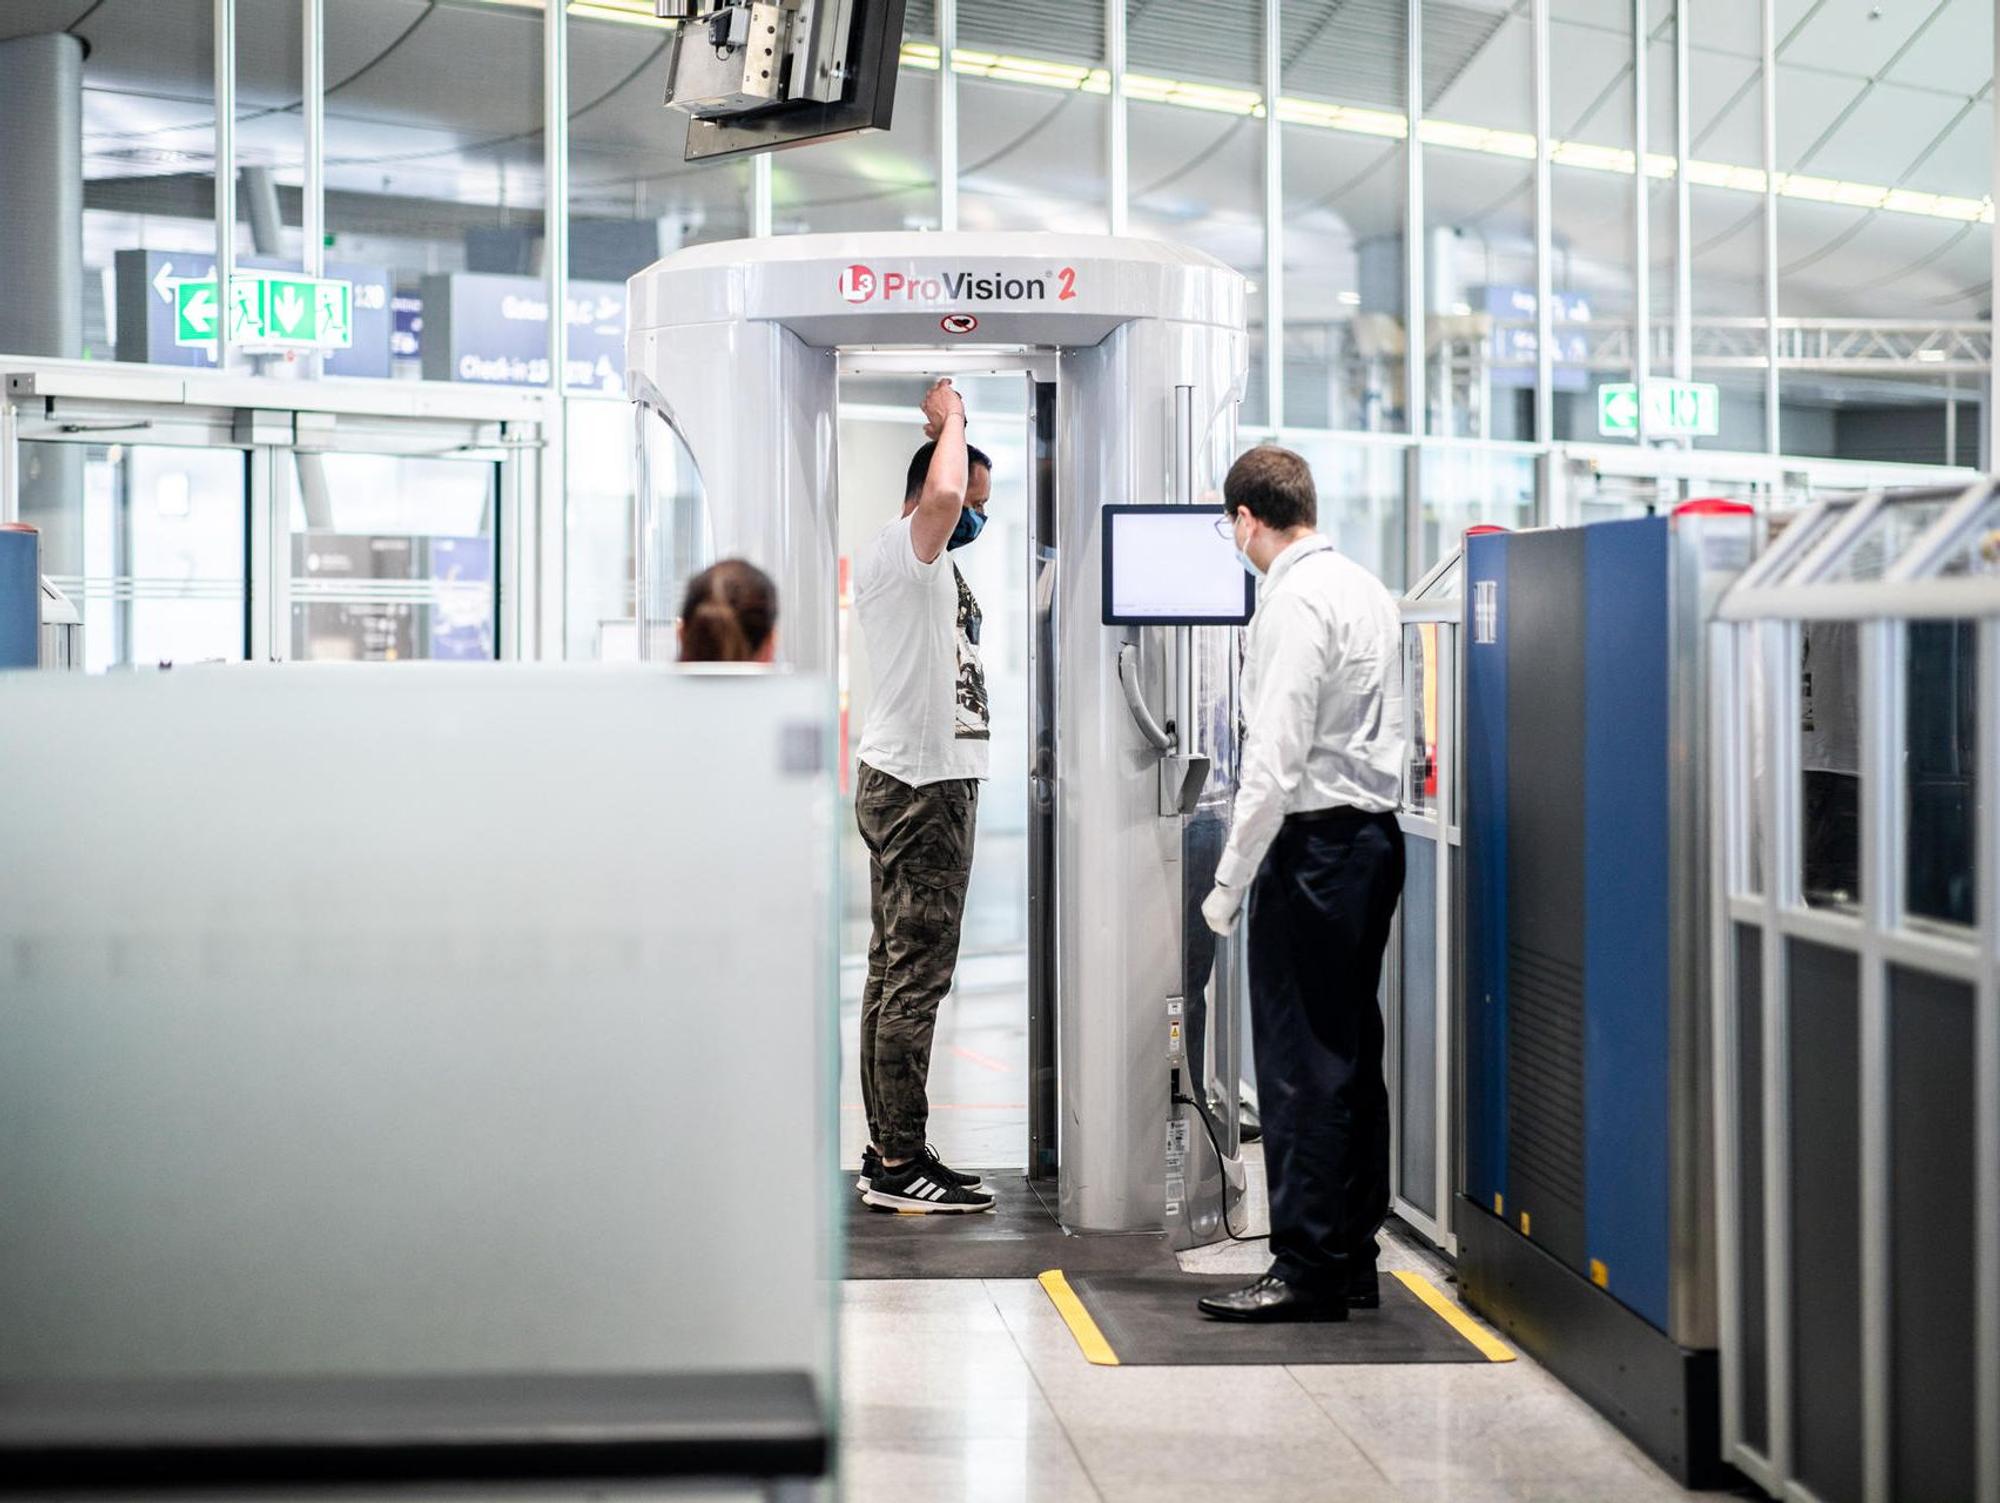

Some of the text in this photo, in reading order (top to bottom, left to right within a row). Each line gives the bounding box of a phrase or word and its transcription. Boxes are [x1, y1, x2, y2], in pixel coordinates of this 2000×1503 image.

[841, 266, 1077, 301] L3 ProVision 2
